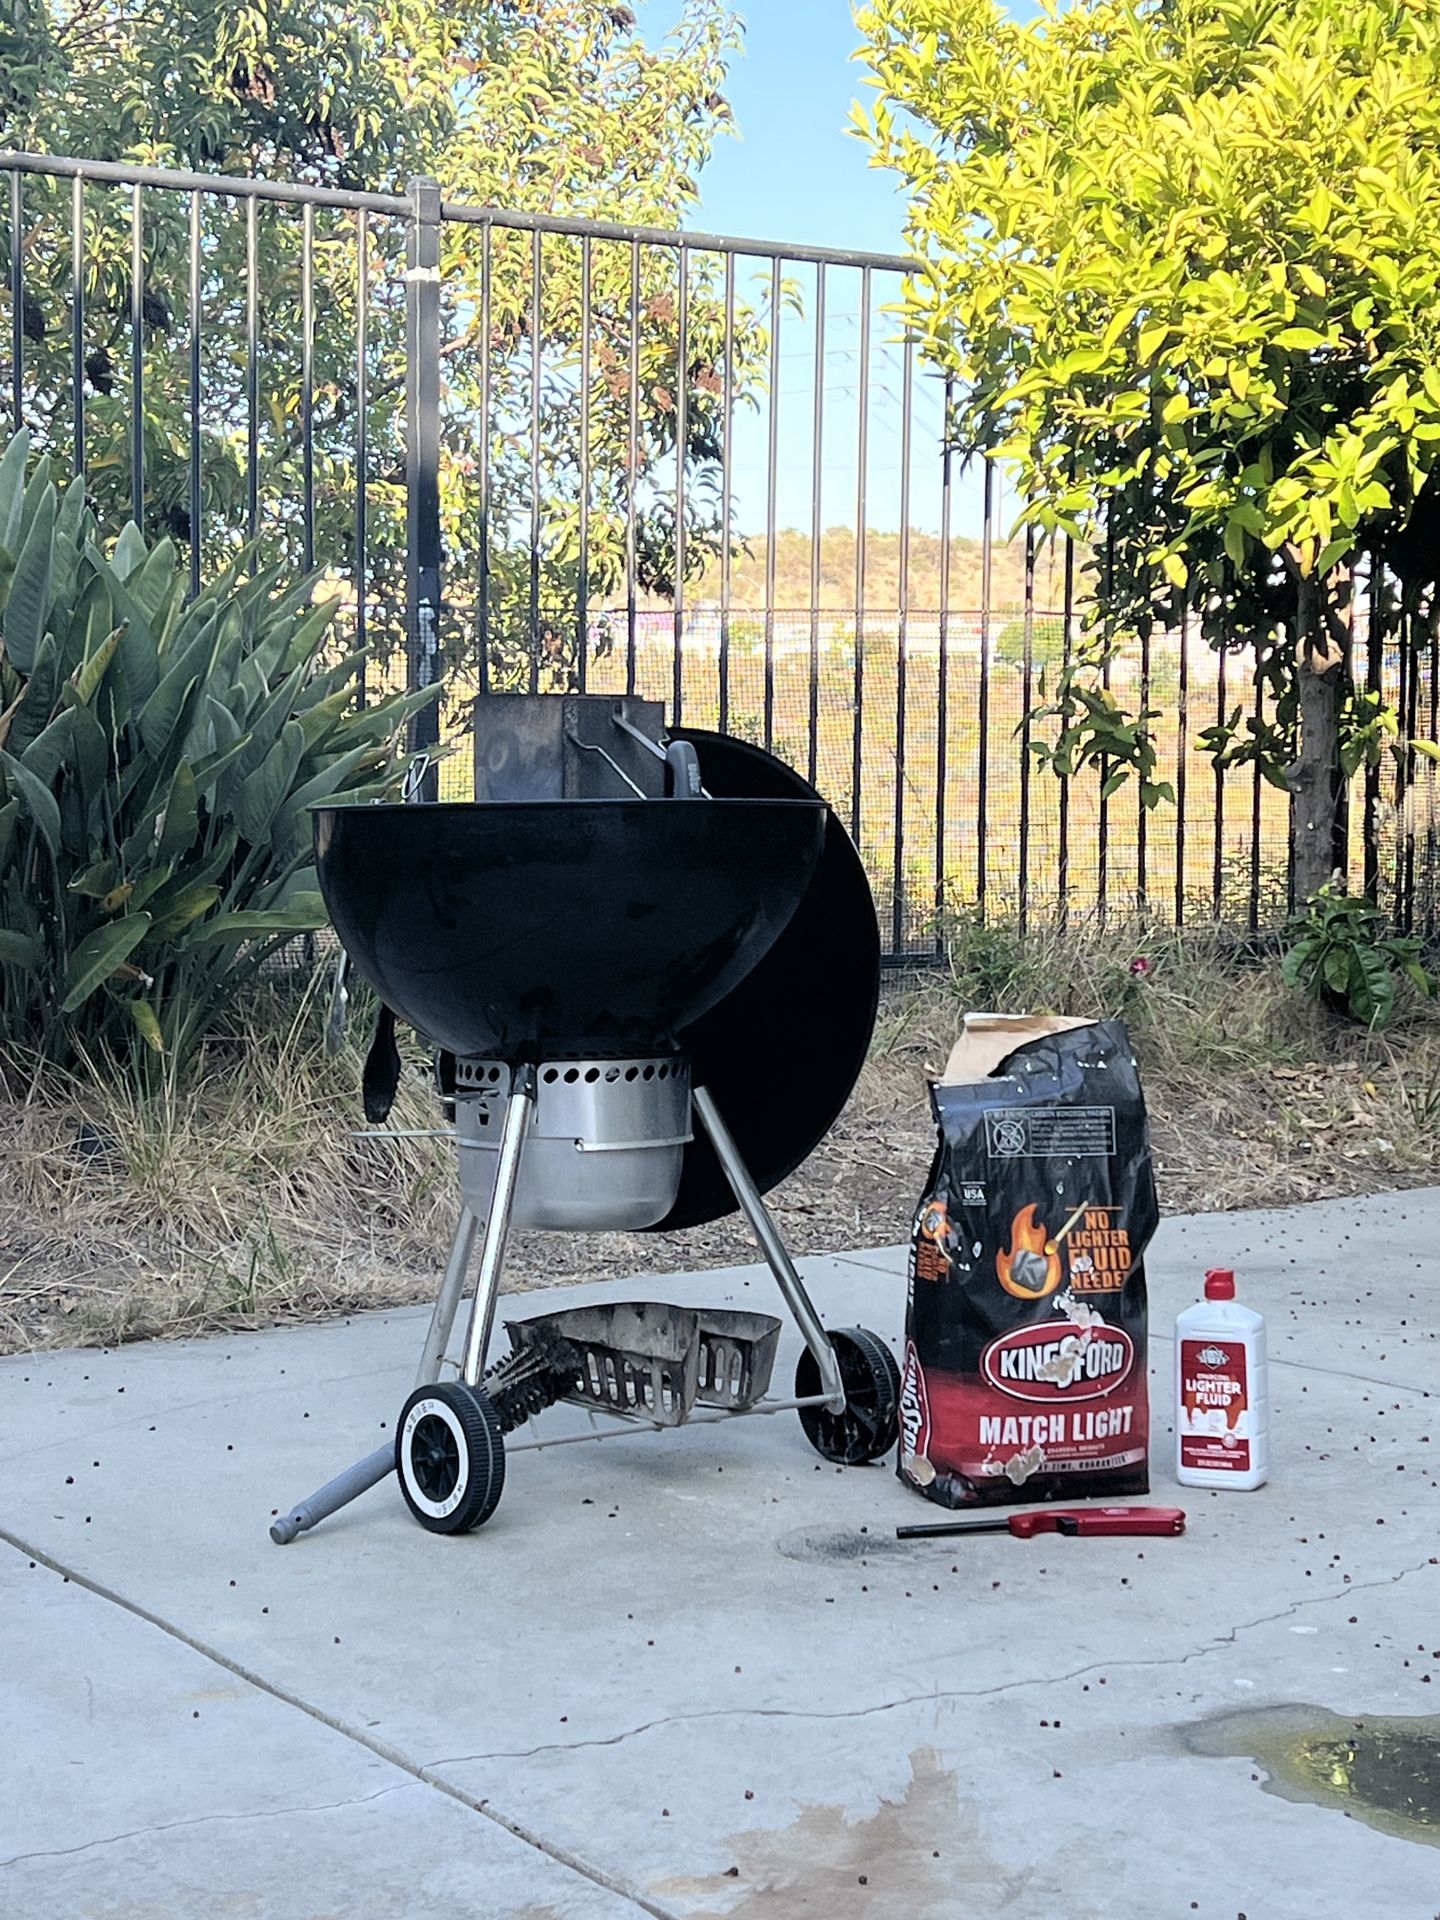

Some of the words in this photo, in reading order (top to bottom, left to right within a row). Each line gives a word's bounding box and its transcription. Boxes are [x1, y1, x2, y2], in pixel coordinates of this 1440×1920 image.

[963, 1188, 985, 1199] USA
[1084, 1211, 1110, 1230] NO
[1066, 1229, 1130, 1248] LIGHTER
[1185, 1378, 1242, 1395] LIGHTER
[900, 1352, 923, 1459] KINGSFOR
[1195, 1392, 1232, 1406] FLUID
[979, 1414, 1065, 1445] MATCH
[1072, 1406, 1133, 1441] LIGHT
